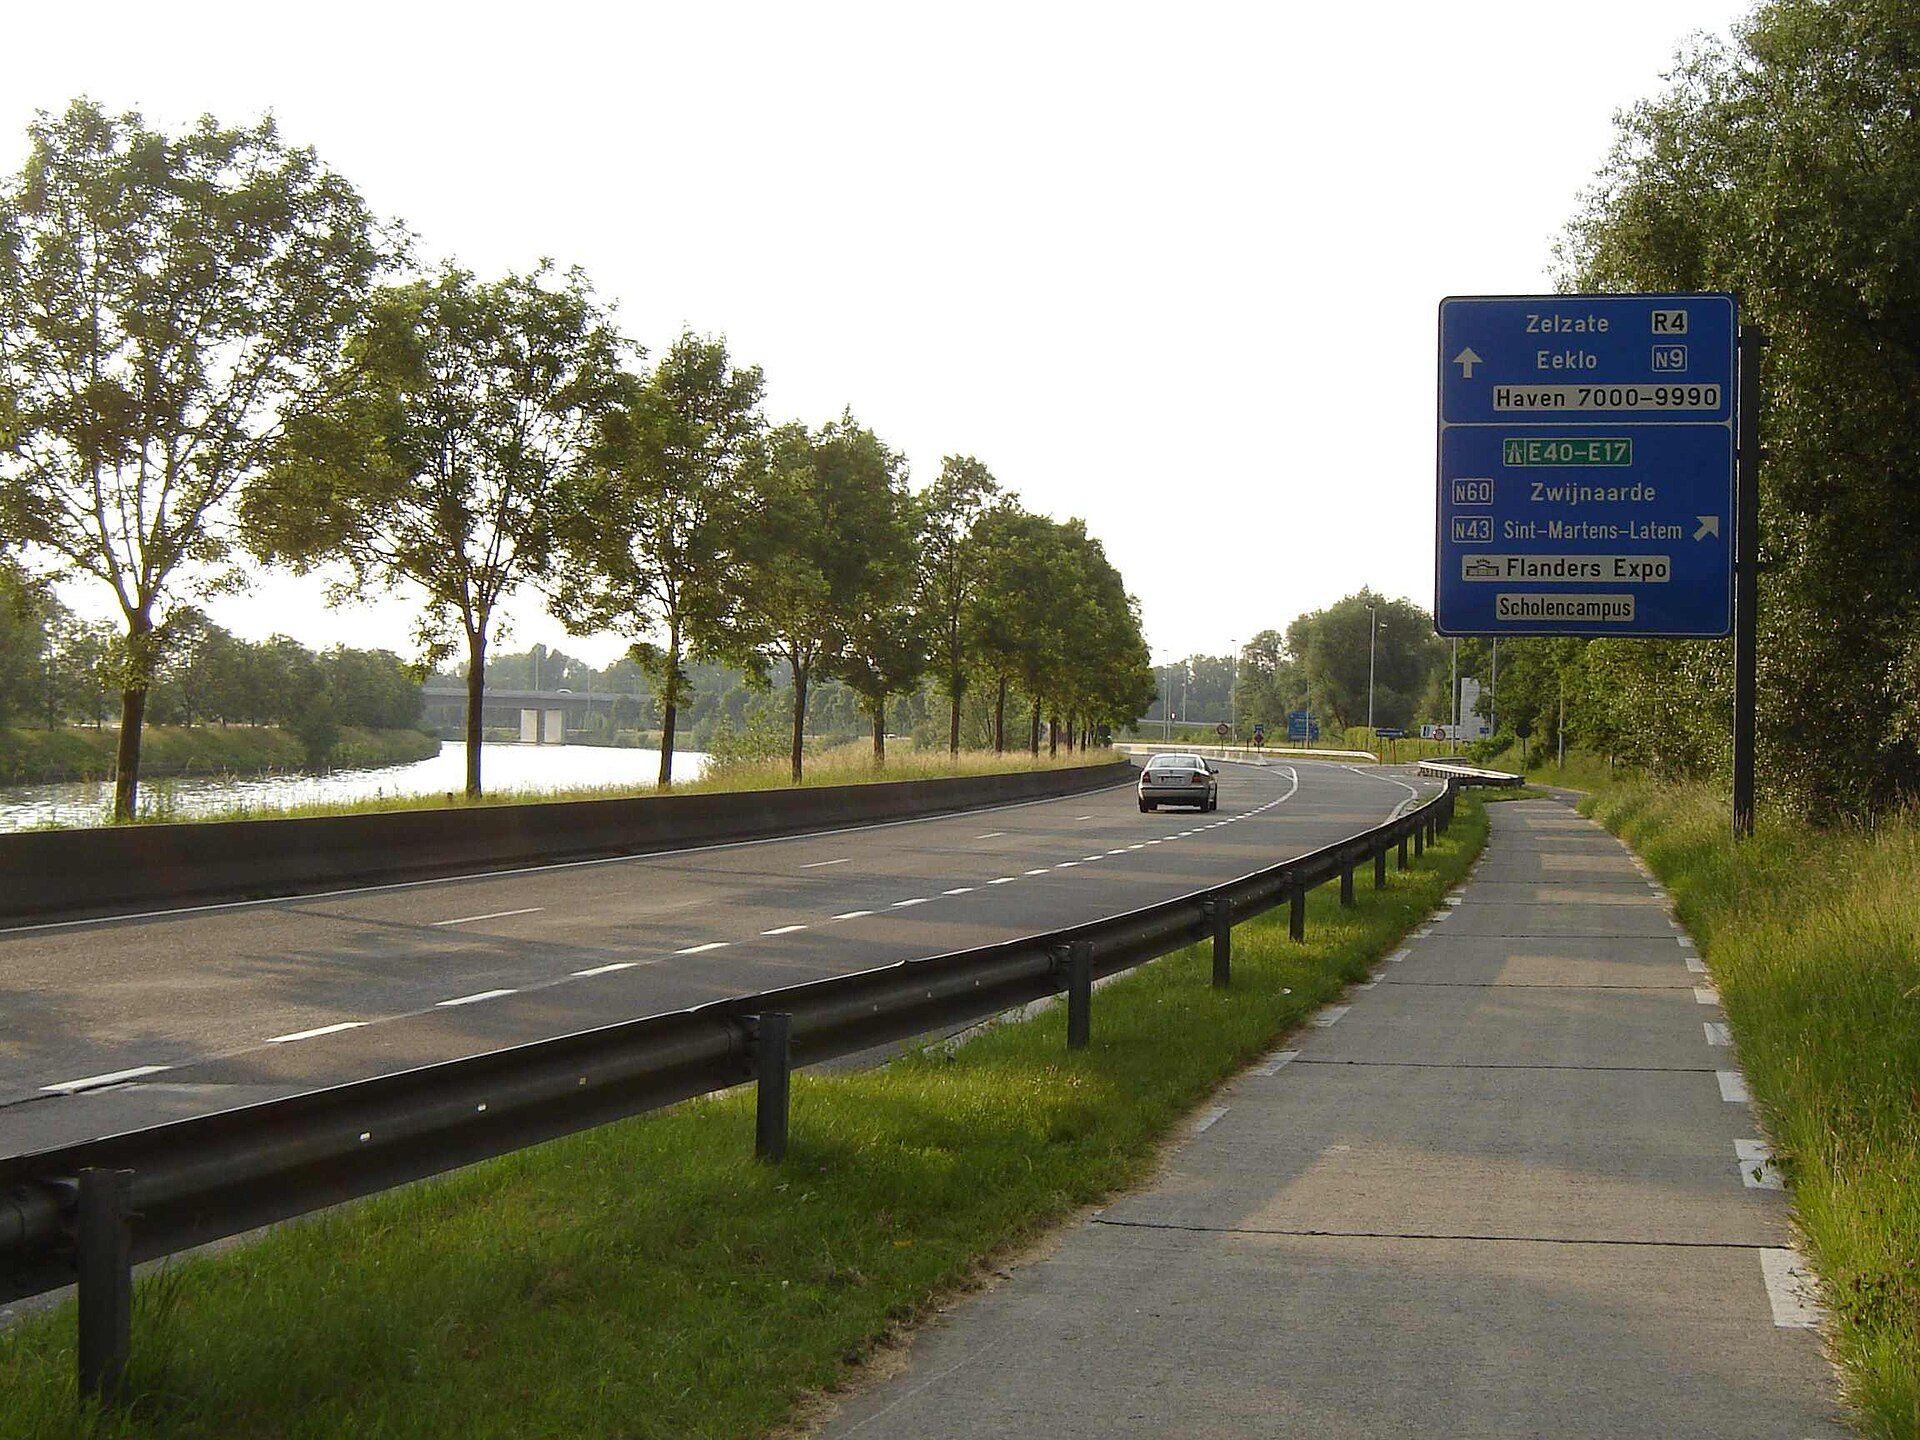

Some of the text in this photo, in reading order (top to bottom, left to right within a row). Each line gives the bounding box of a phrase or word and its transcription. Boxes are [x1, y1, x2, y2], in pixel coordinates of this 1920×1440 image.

[1526, 314, 1609, 333] Zelzate
[1654, 312, 1685, 332] R4
[1537, 351, 1597, 369] Eeklo
[1655, 350, 1684, 369] N9
[1497, 388, 1717, 407] Haven 7000-9990
[1528, 443, 1628, 461] E40-E17
[1456, 484, 1490, 501] N60
[1531, 482, 1656, 505] Zwijnaarde
[1455, 522, 1490, 539] N43
[1504, 521, 1682, 540] Sint-Martens-Latem
[1507, 558, 1667, 582] Flanders Expo
[1500, 598, 1631, 620] Scholencampus
